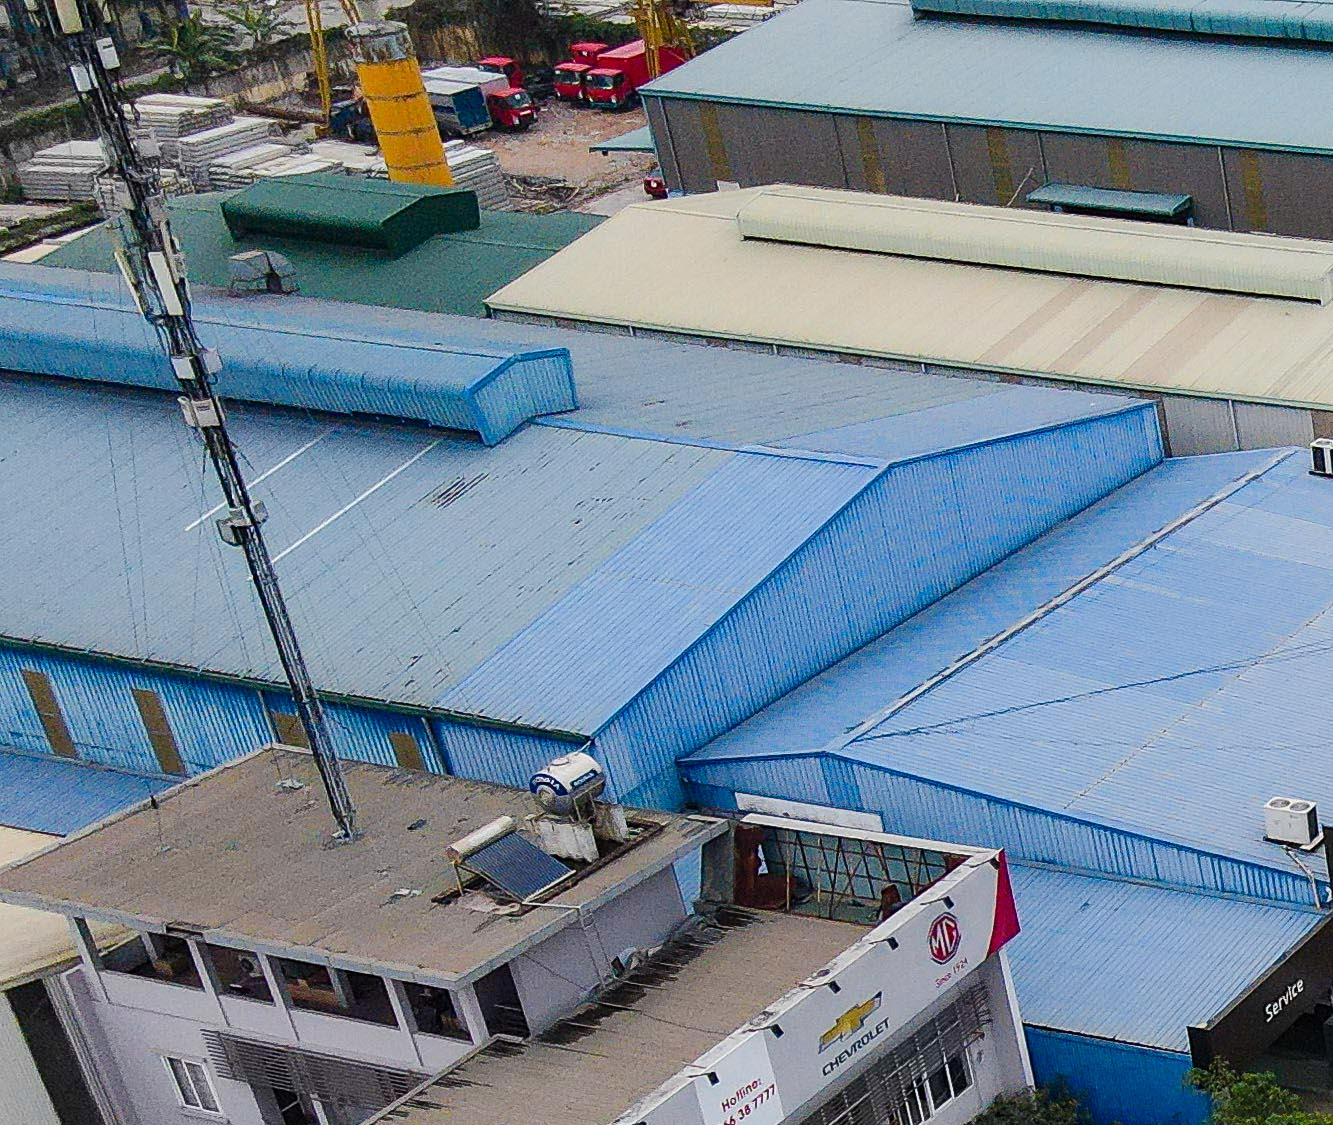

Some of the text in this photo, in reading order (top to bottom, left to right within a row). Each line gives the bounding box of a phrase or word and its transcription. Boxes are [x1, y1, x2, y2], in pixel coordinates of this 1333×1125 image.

[1265, 978, 1304, 1023] Service
[822, 1017, 890, 1077] CHEVROLET
[738, 1104, 751, 1120] 38
[752, 1083, 775, 1109] 7777
